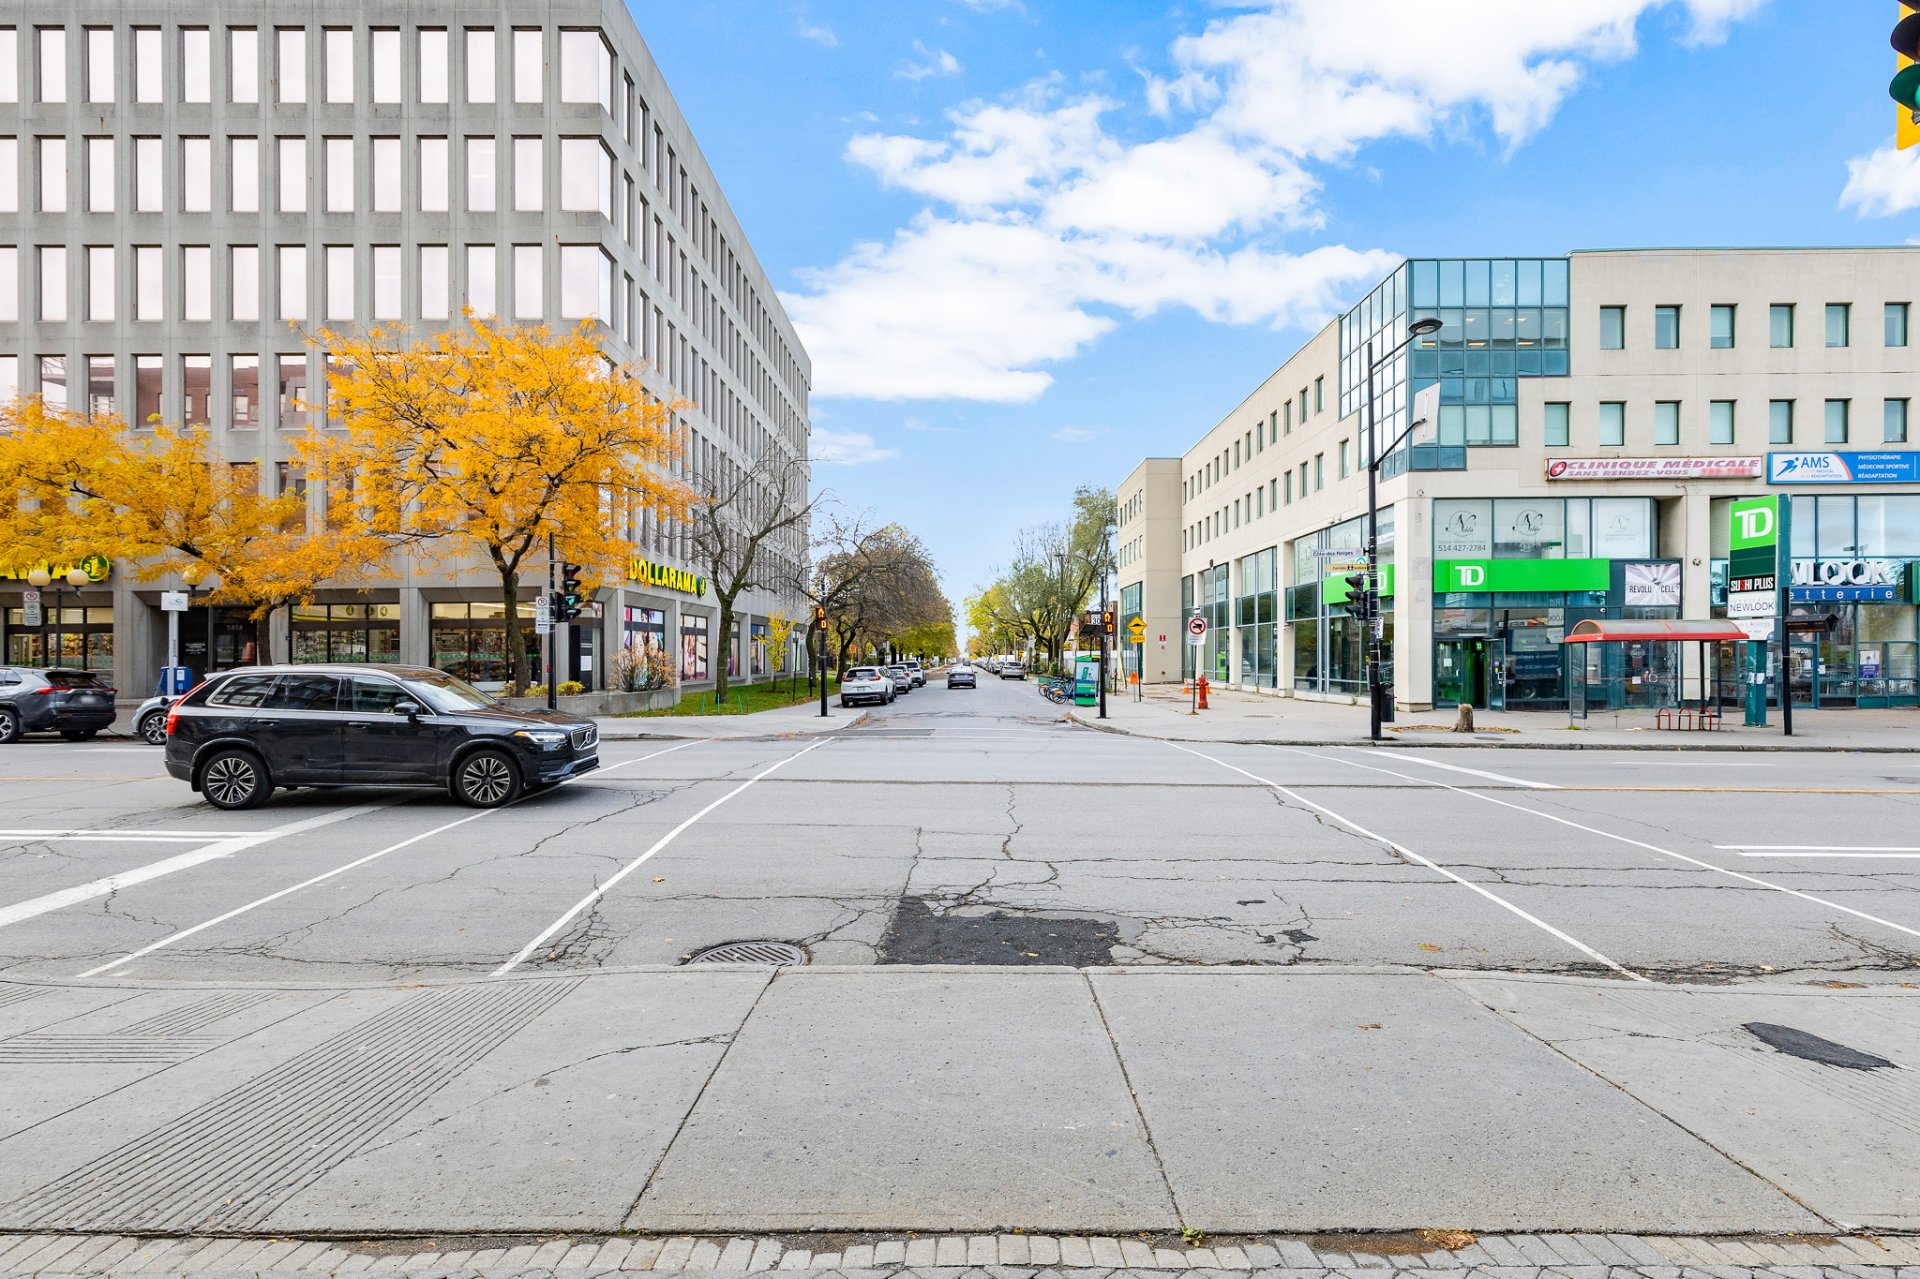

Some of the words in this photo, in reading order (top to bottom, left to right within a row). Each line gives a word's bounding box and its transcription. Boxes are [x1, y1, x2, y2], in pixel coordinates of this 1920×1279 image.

[1567, 461, 1658, 469] CLINIQUE
[1663, 459, 1759, 468] MÉDICALE
[1801, 456, 1830, 468] AMS
[1734, 507, 1774, 540] TD
[1453, 544, 1486, 552] 427-2784
[629, 557, 697, 594] DOLLARAMA
[1455, 565, 1485, 586] TD
[1790, 560, 1892, 586] WLOOK
[1629, 585, 1652, 593] REVOLU
[1660, 585, 1675, 593] CELL
[1730, 579, 1753, 592] SUSHI
[1754, 577, 1774, 590] PLUS
[1790, 589, 1893, 599] etterie
[1730, 601, 1775, 612] NEWLOOK
